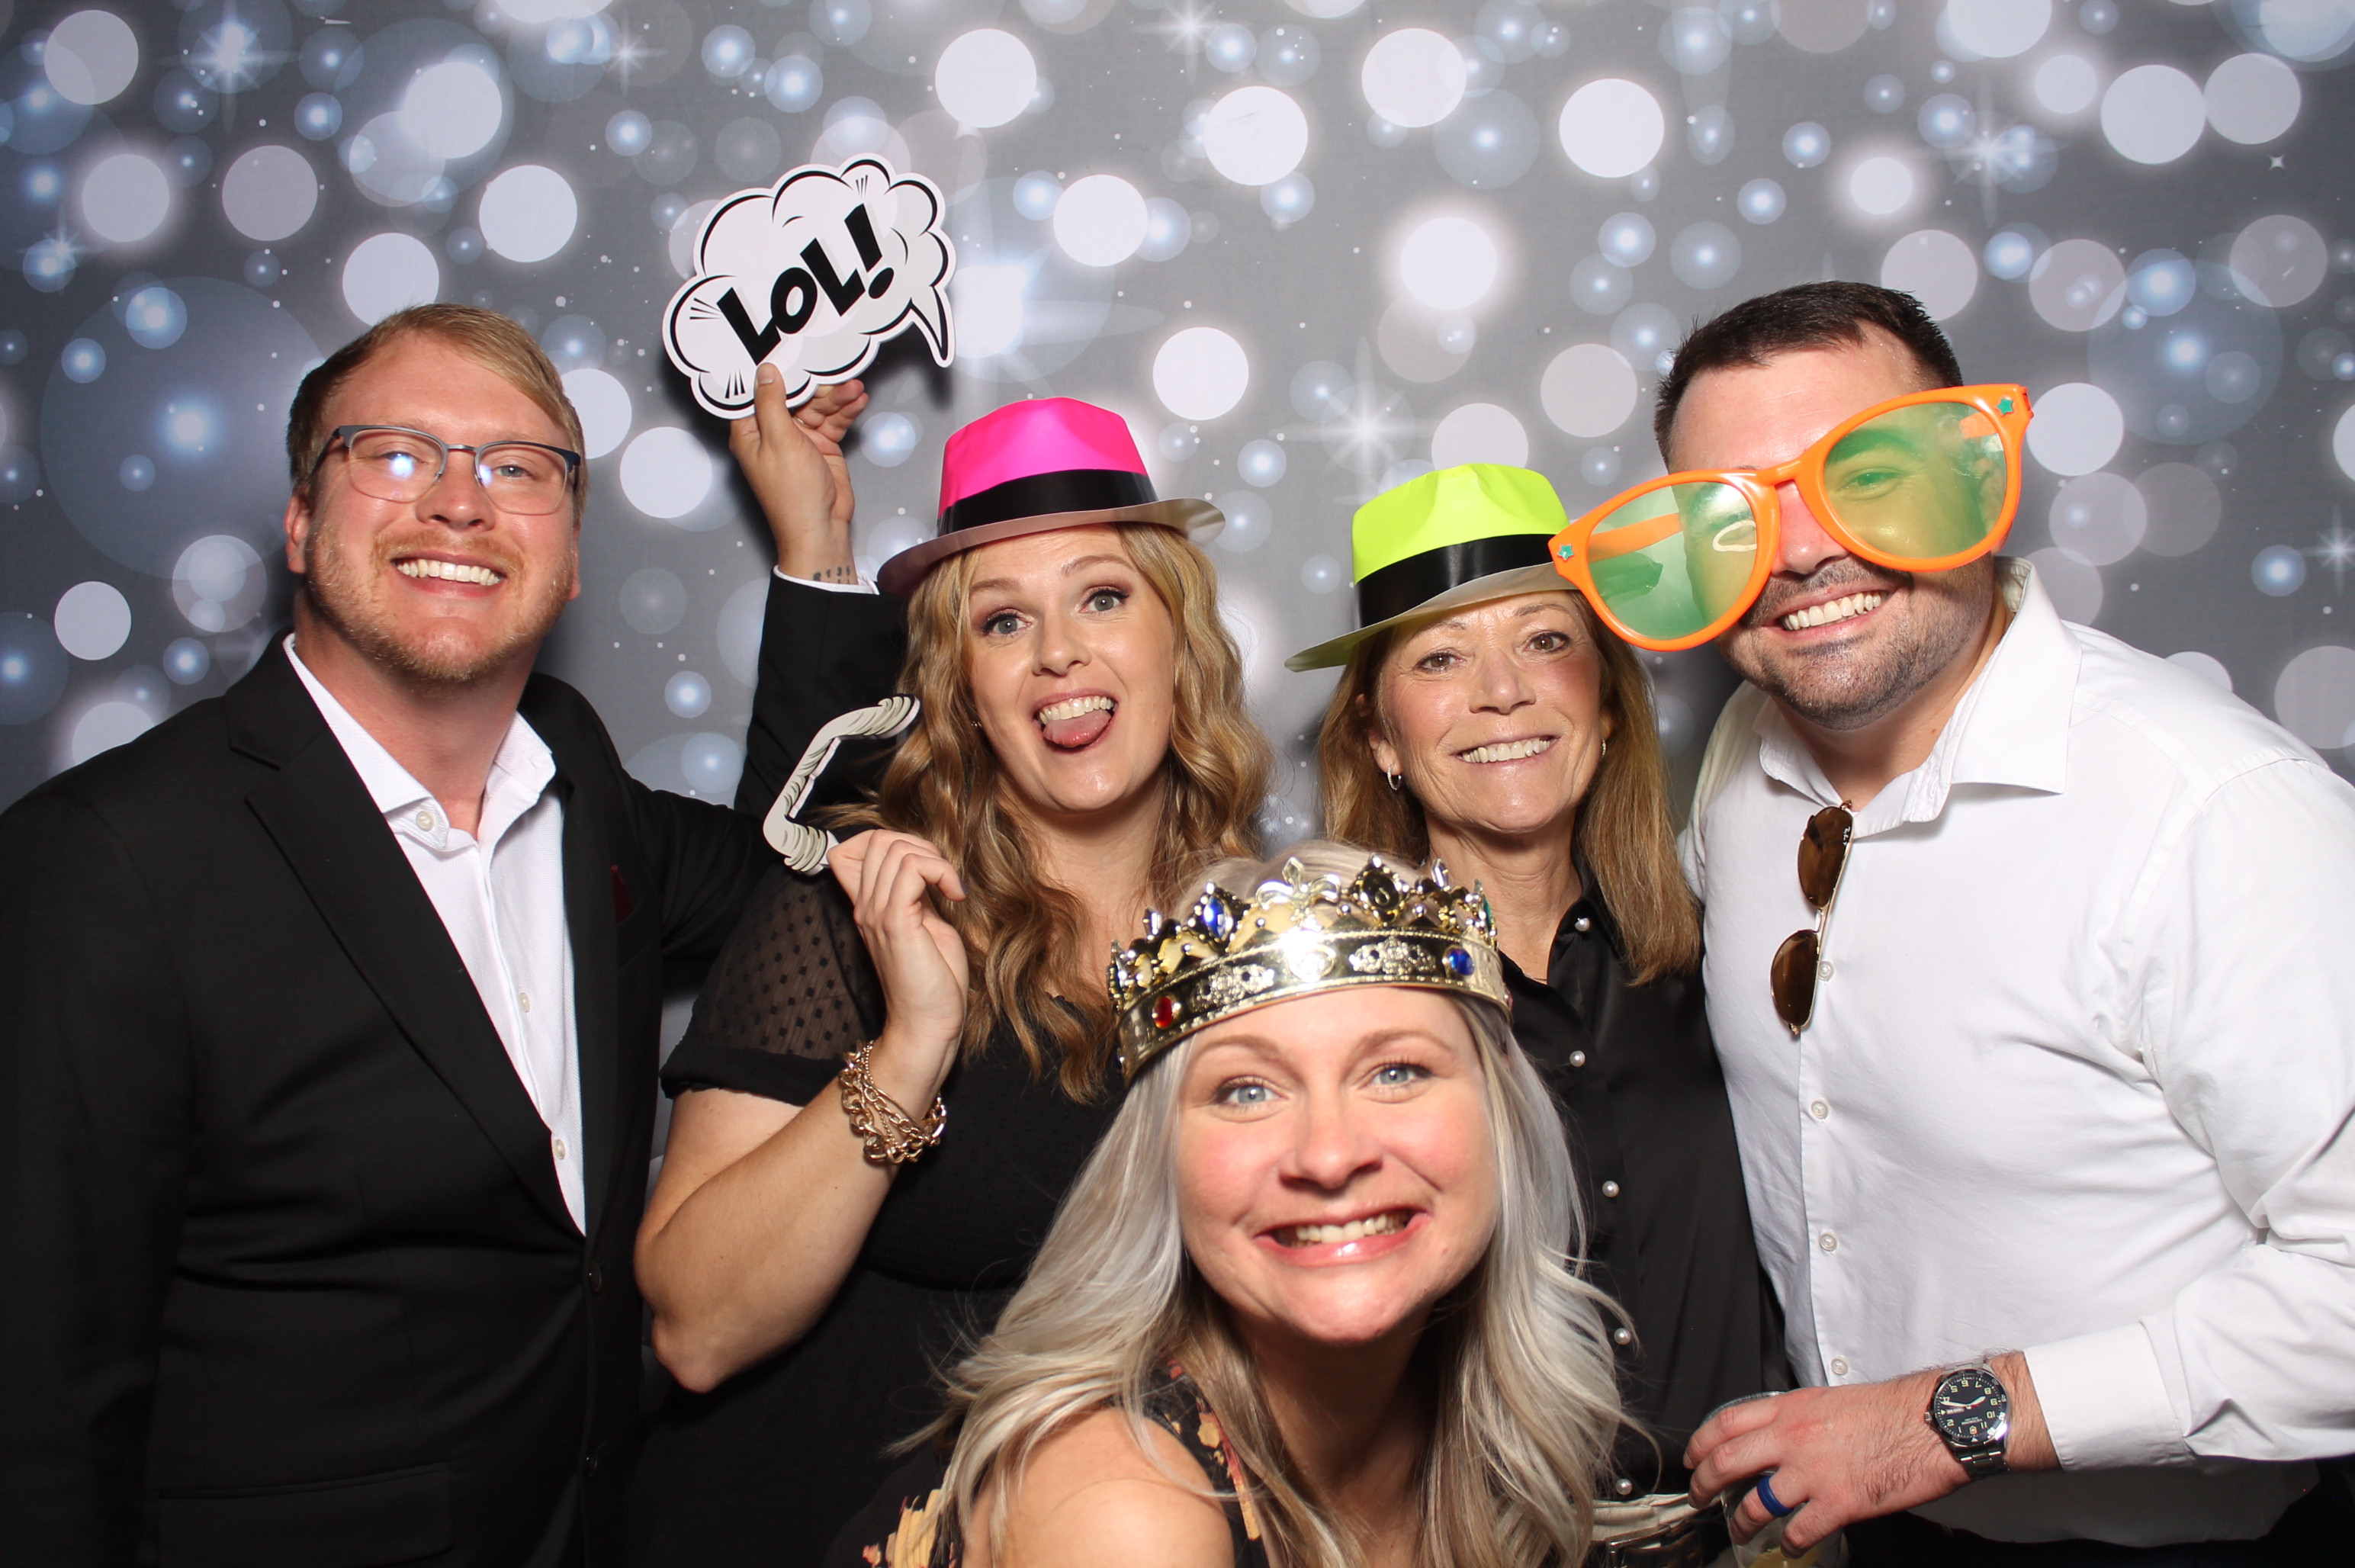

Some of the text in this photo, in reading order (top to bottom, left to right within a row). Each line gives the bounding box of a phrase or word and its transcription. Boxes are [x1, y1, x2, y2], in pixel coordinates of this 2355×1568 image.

[716, 204, 894, 366] LOL!
[1986, 1411, 1996, 1419] 10
[1946, 1419, 1955, 1427] 2
[1981, 1421, 1987, 1429] 11
